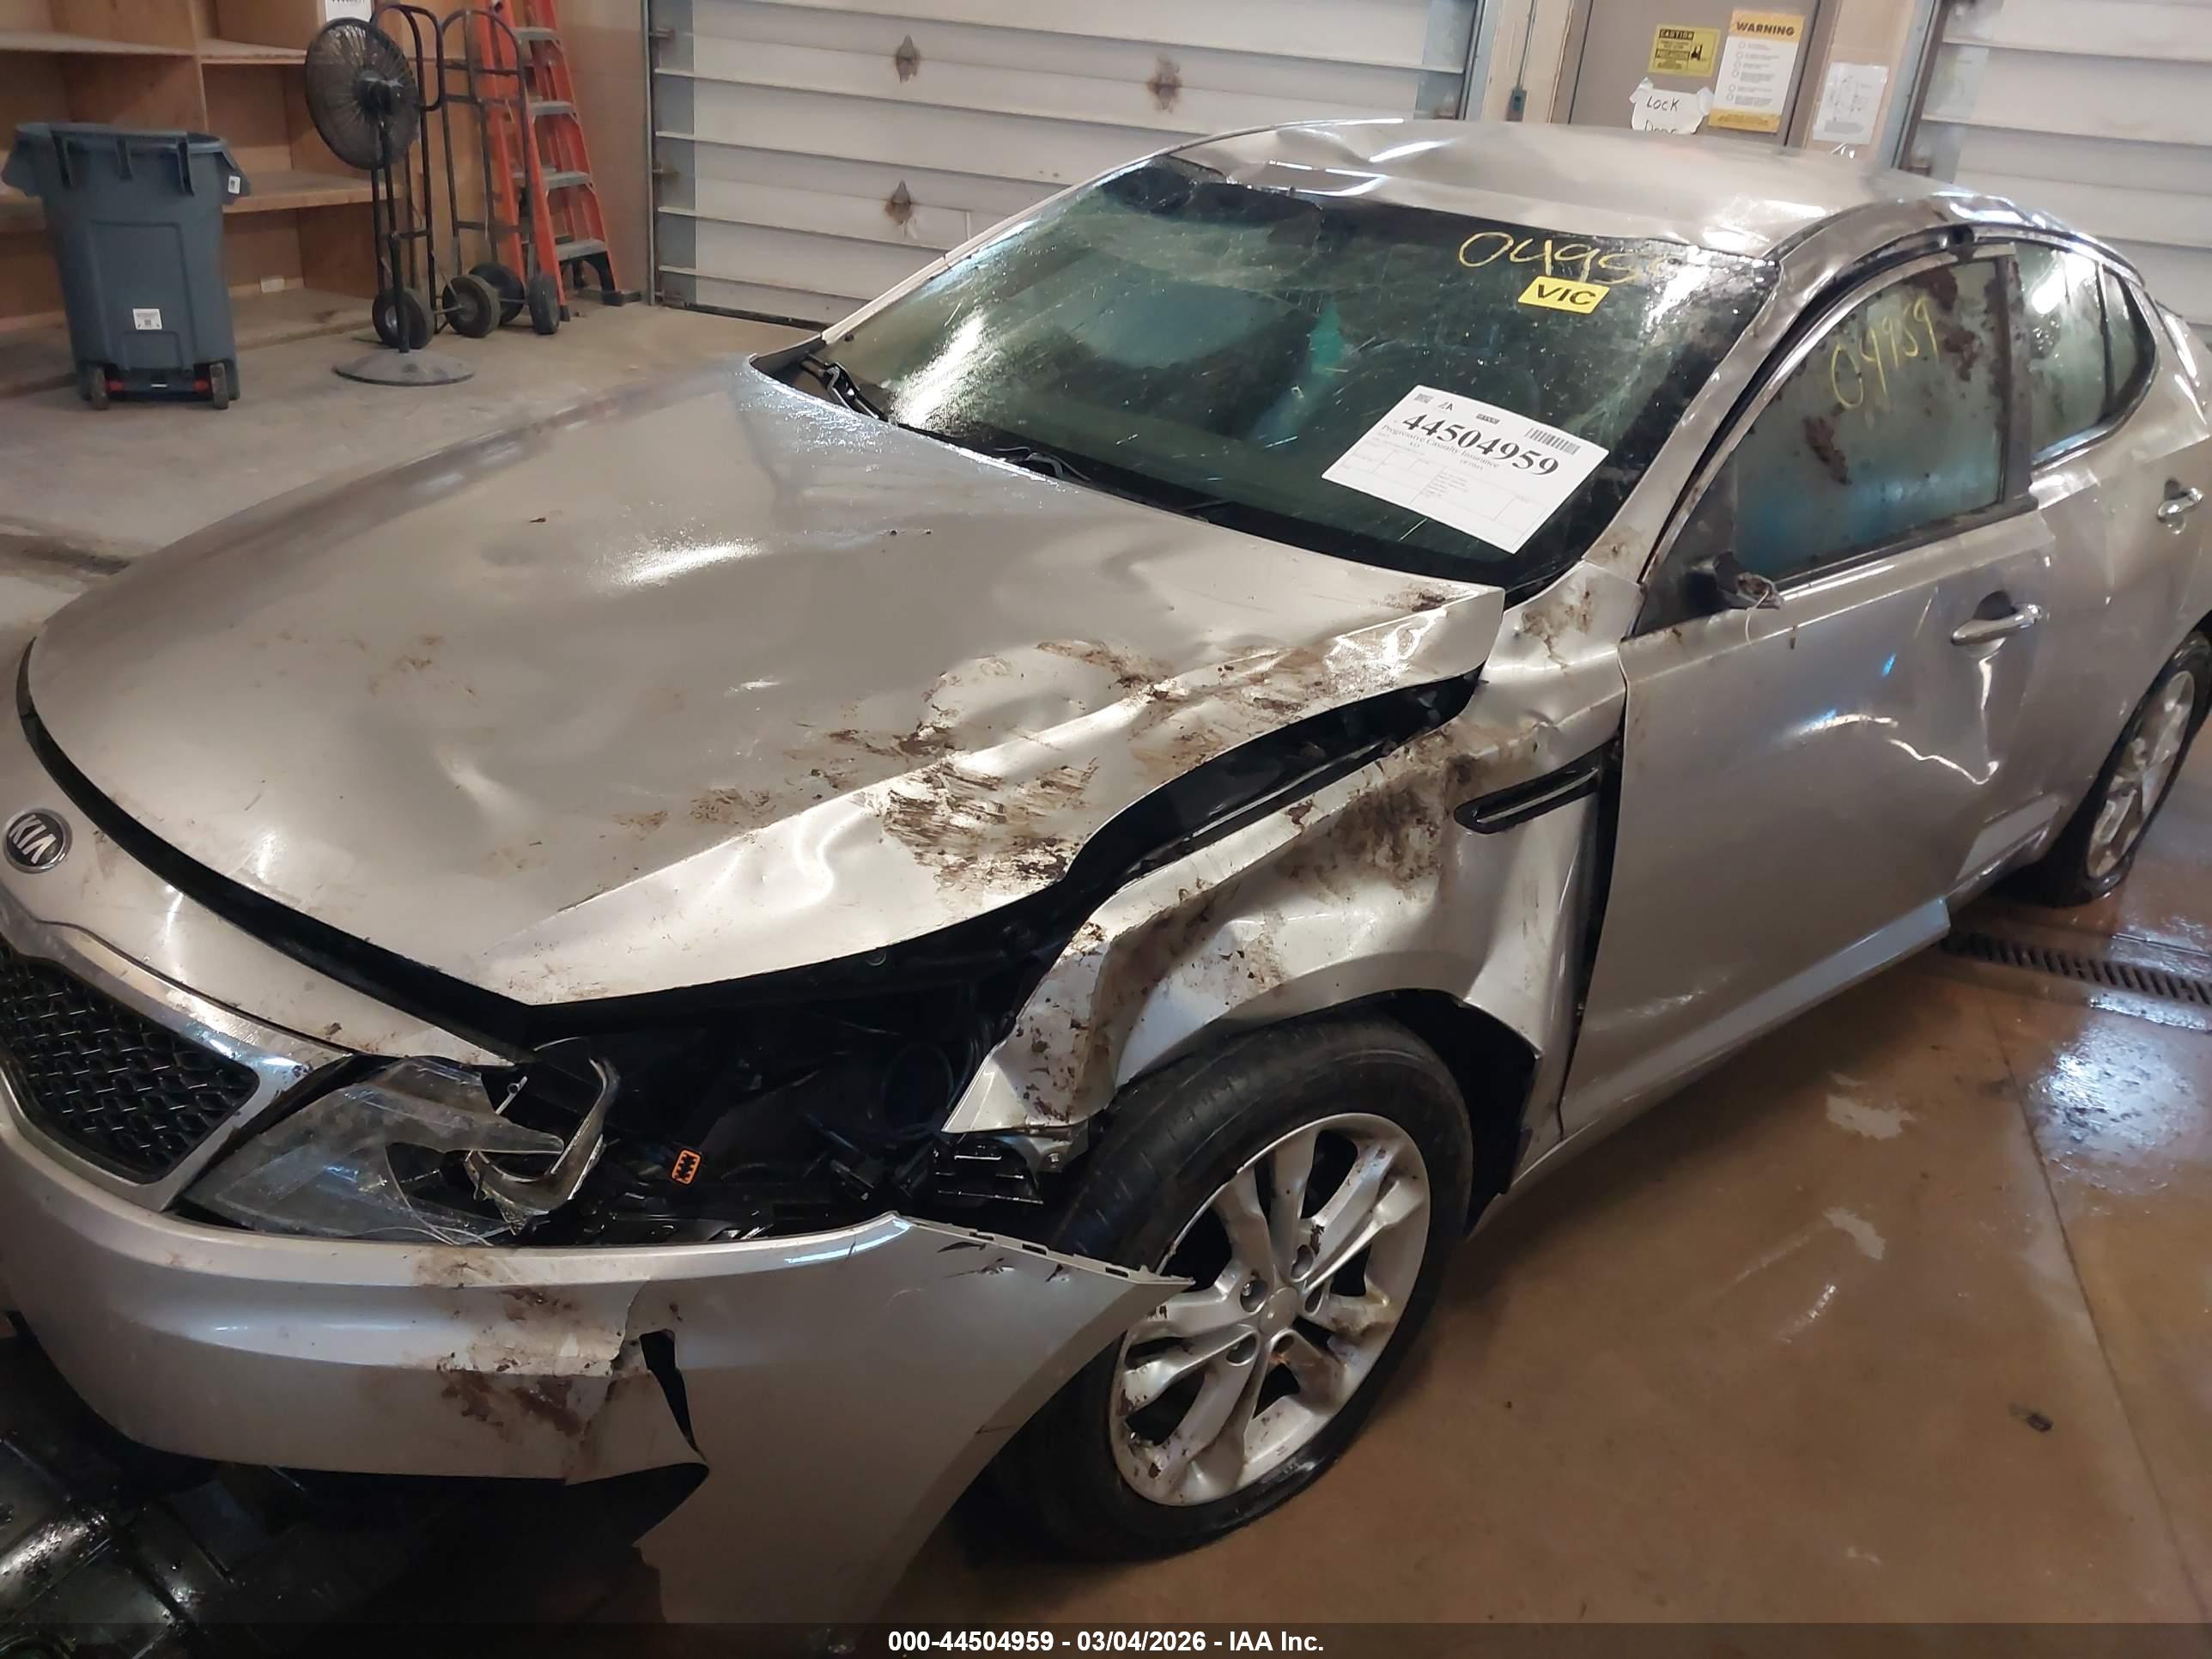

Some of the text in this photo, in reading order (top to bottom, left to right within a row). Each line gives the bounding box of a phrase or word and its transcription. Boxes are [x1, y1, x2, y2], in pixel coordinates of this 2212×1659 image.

[1659, 29, 1694, 40] CAUTION
[1735, 21, 1796, 36] WARNING
[1459, 231, 1666, 285] 0495
[1537, 284, 1596, 305] VIC
[1401, 414, 1559, 476] 44504959
[9, 813, 57, 865] KIA
